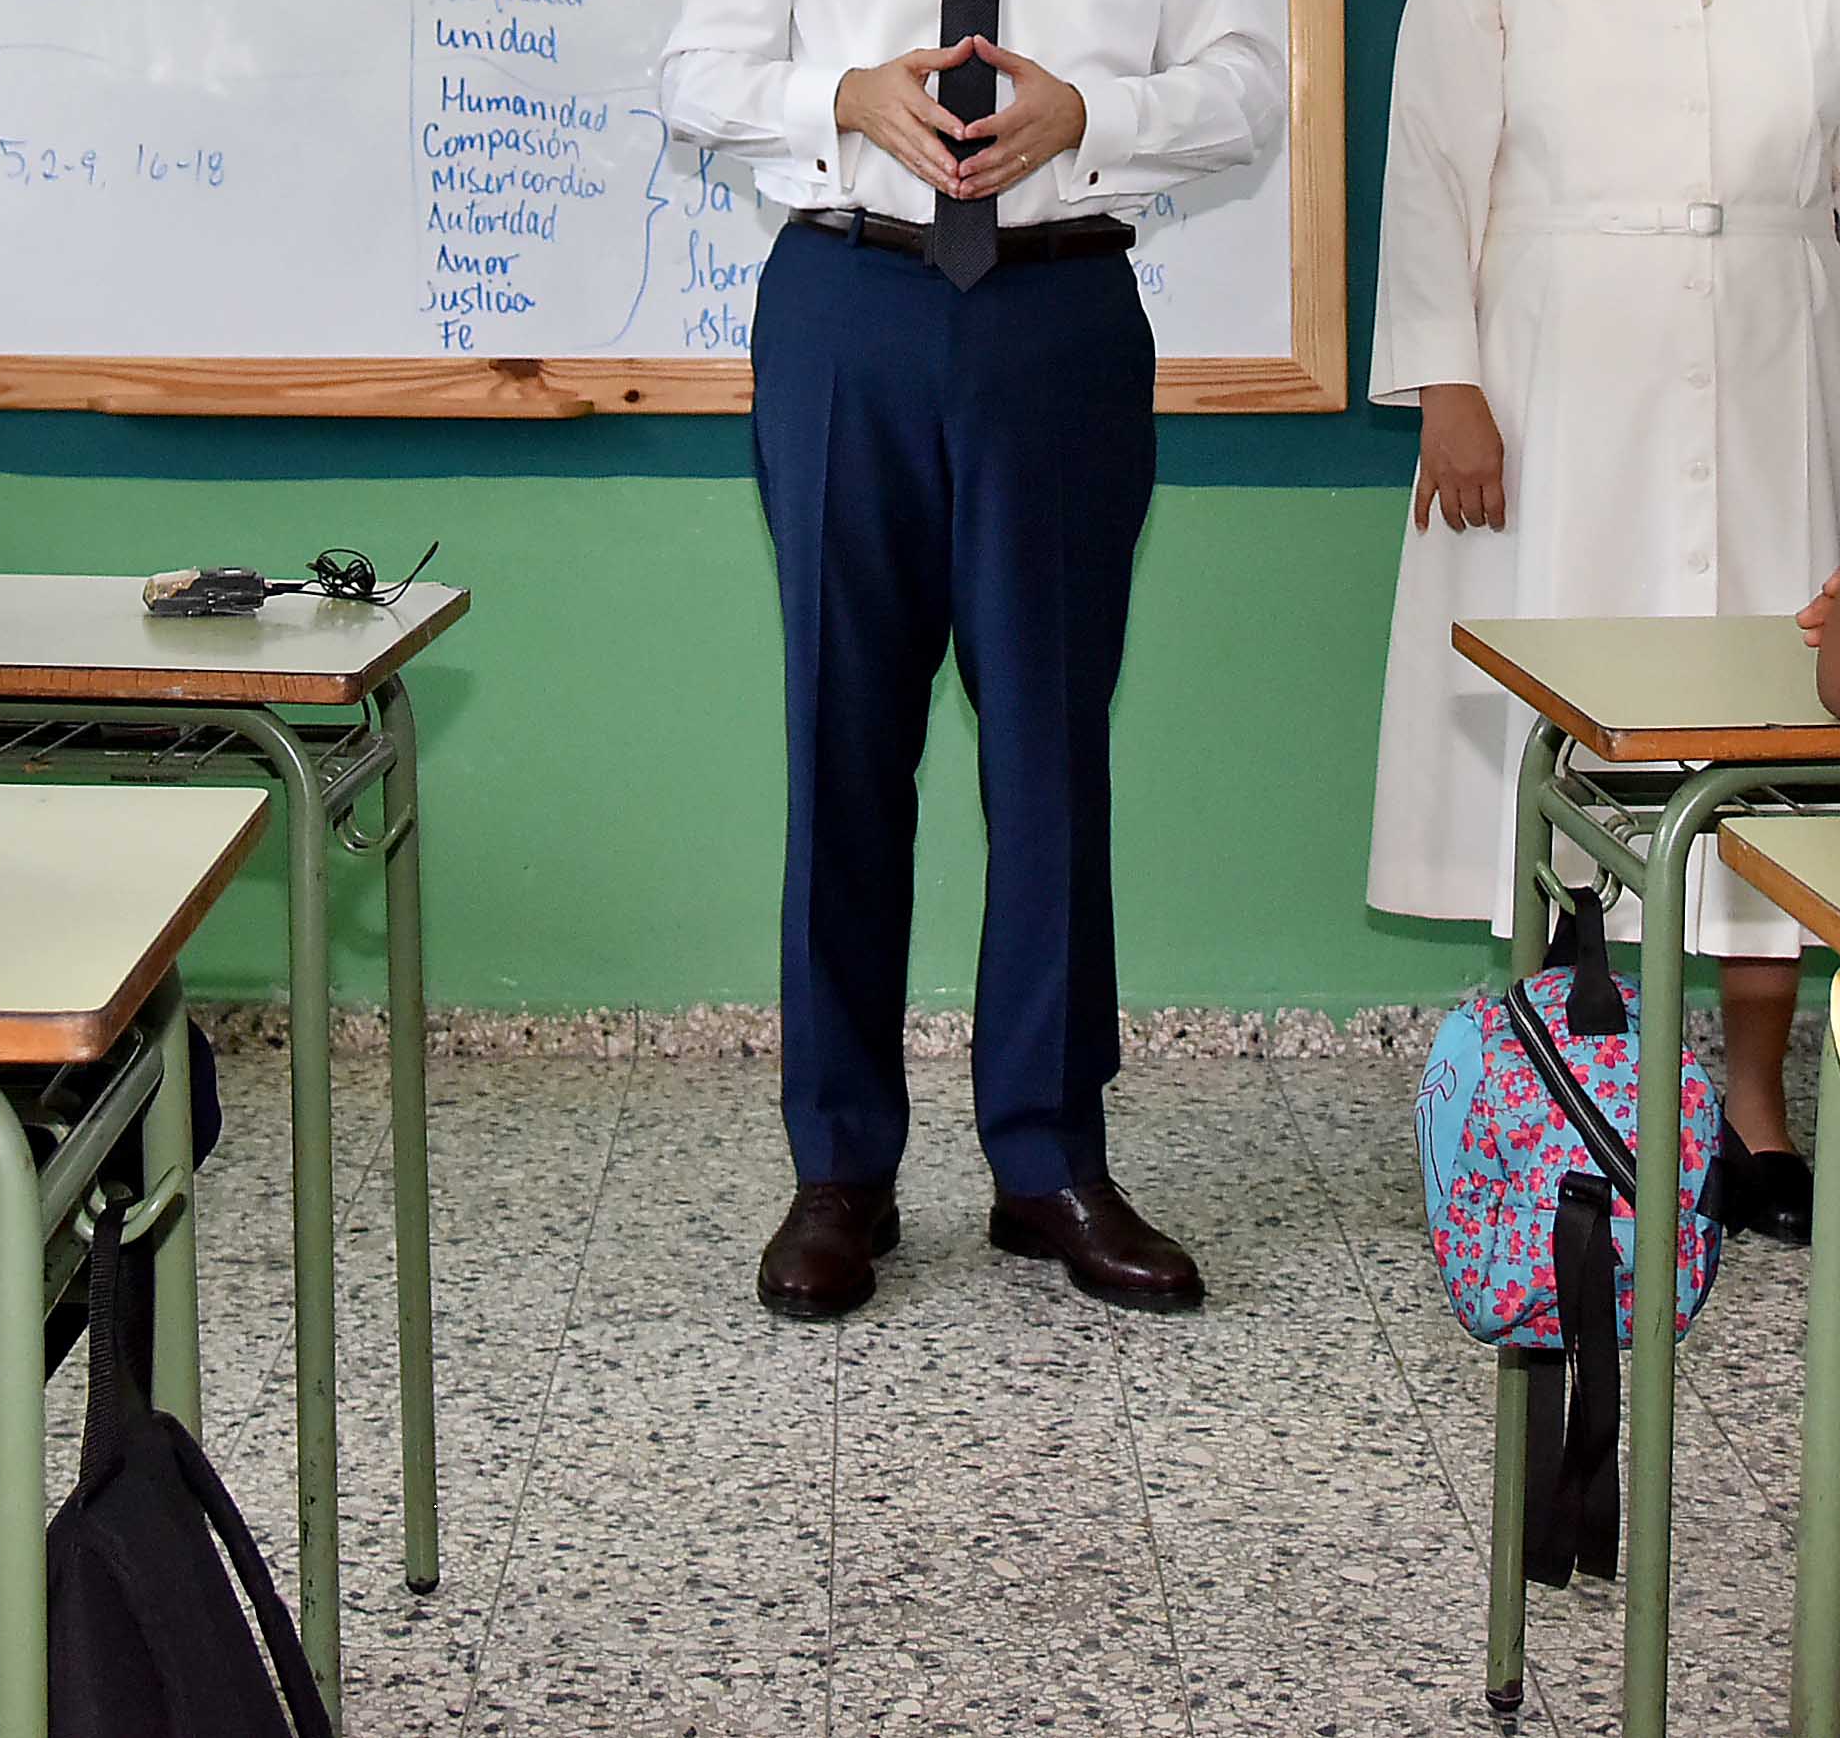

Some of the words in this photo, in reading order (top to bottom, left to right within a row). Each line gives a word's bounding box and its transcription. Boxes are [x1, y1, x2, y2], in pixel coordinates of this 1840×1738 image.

[441, 76, 608, 132] Humanidad
[432, 163, 606, 198] Misericordia
[427, 199, 558, 243] Autoridad
[436, 243, 520, 276] Amor
[435, 318, 475, 352] Fe
